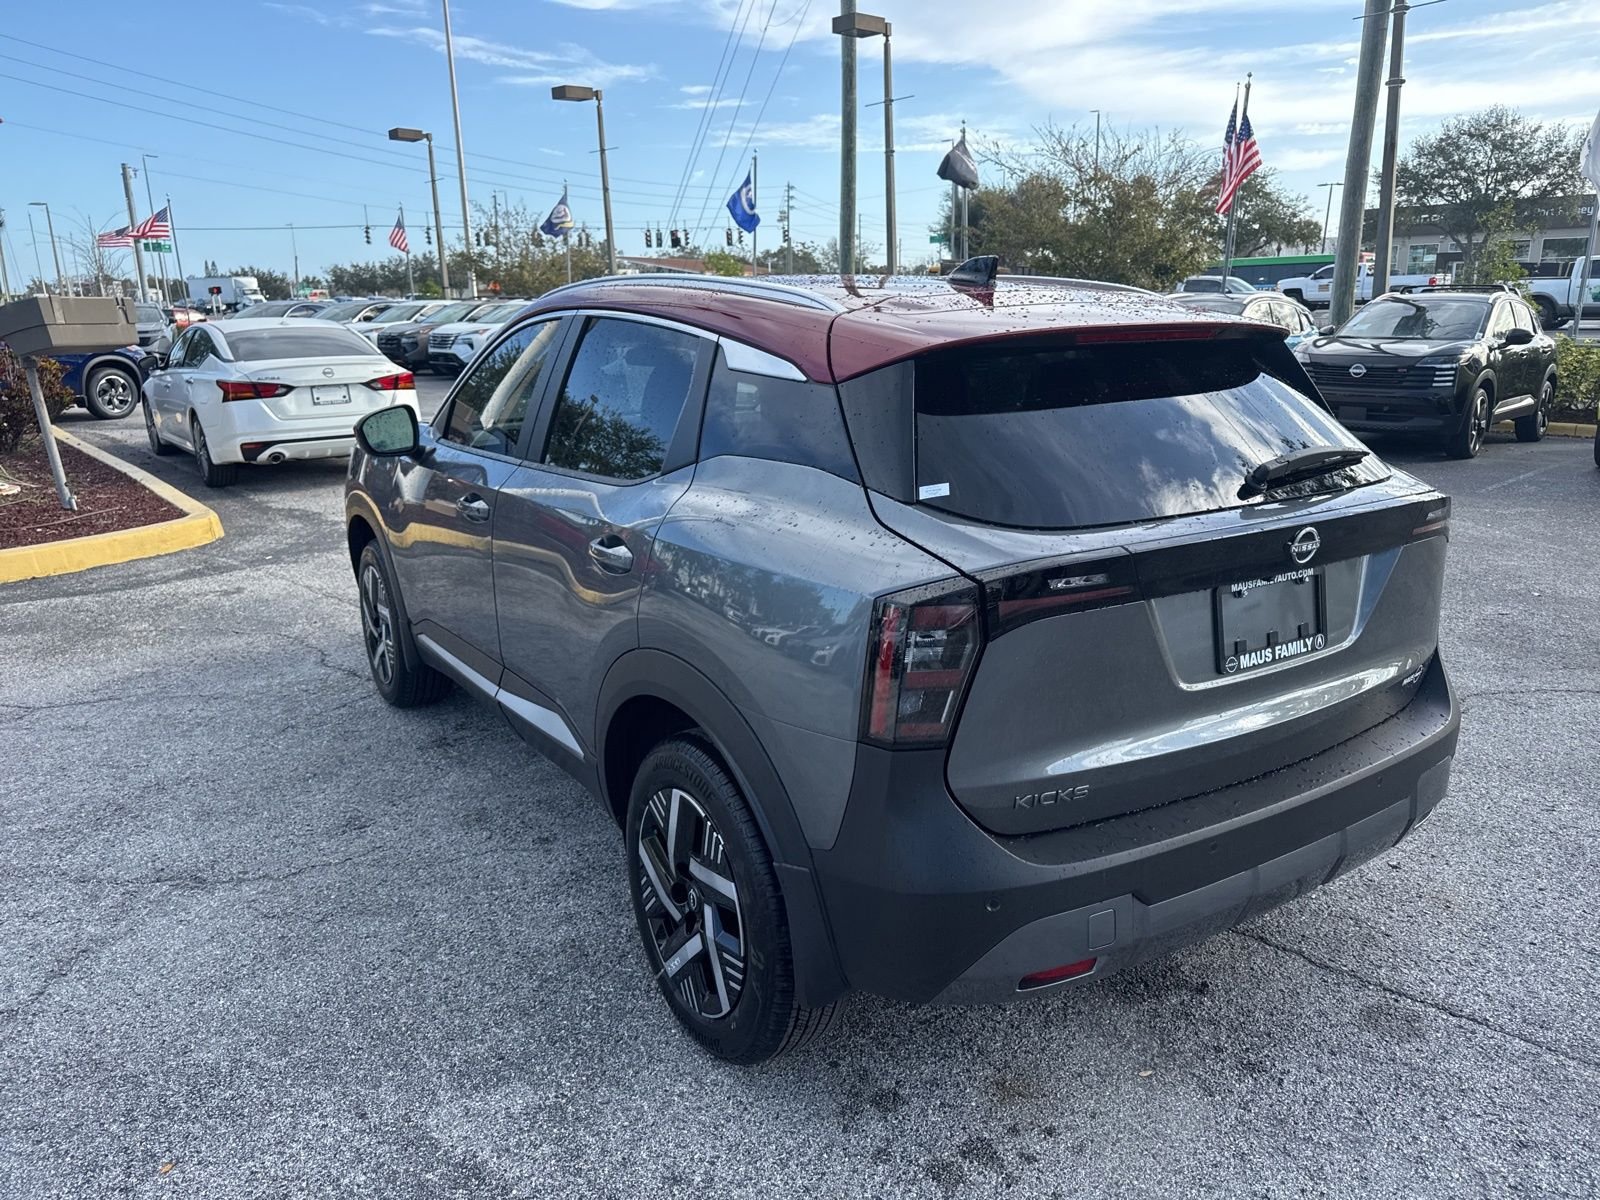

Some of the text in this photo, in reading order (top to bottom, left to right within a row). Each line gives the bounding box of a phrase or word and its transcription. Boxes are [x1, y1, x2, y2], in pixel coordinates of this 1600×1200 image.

[1291, 541, 1320, 552] NISSAN
[1240, 637, 1313, 669] MAUS FAMILY
[1013, 784, 1089, 809] KICKS
